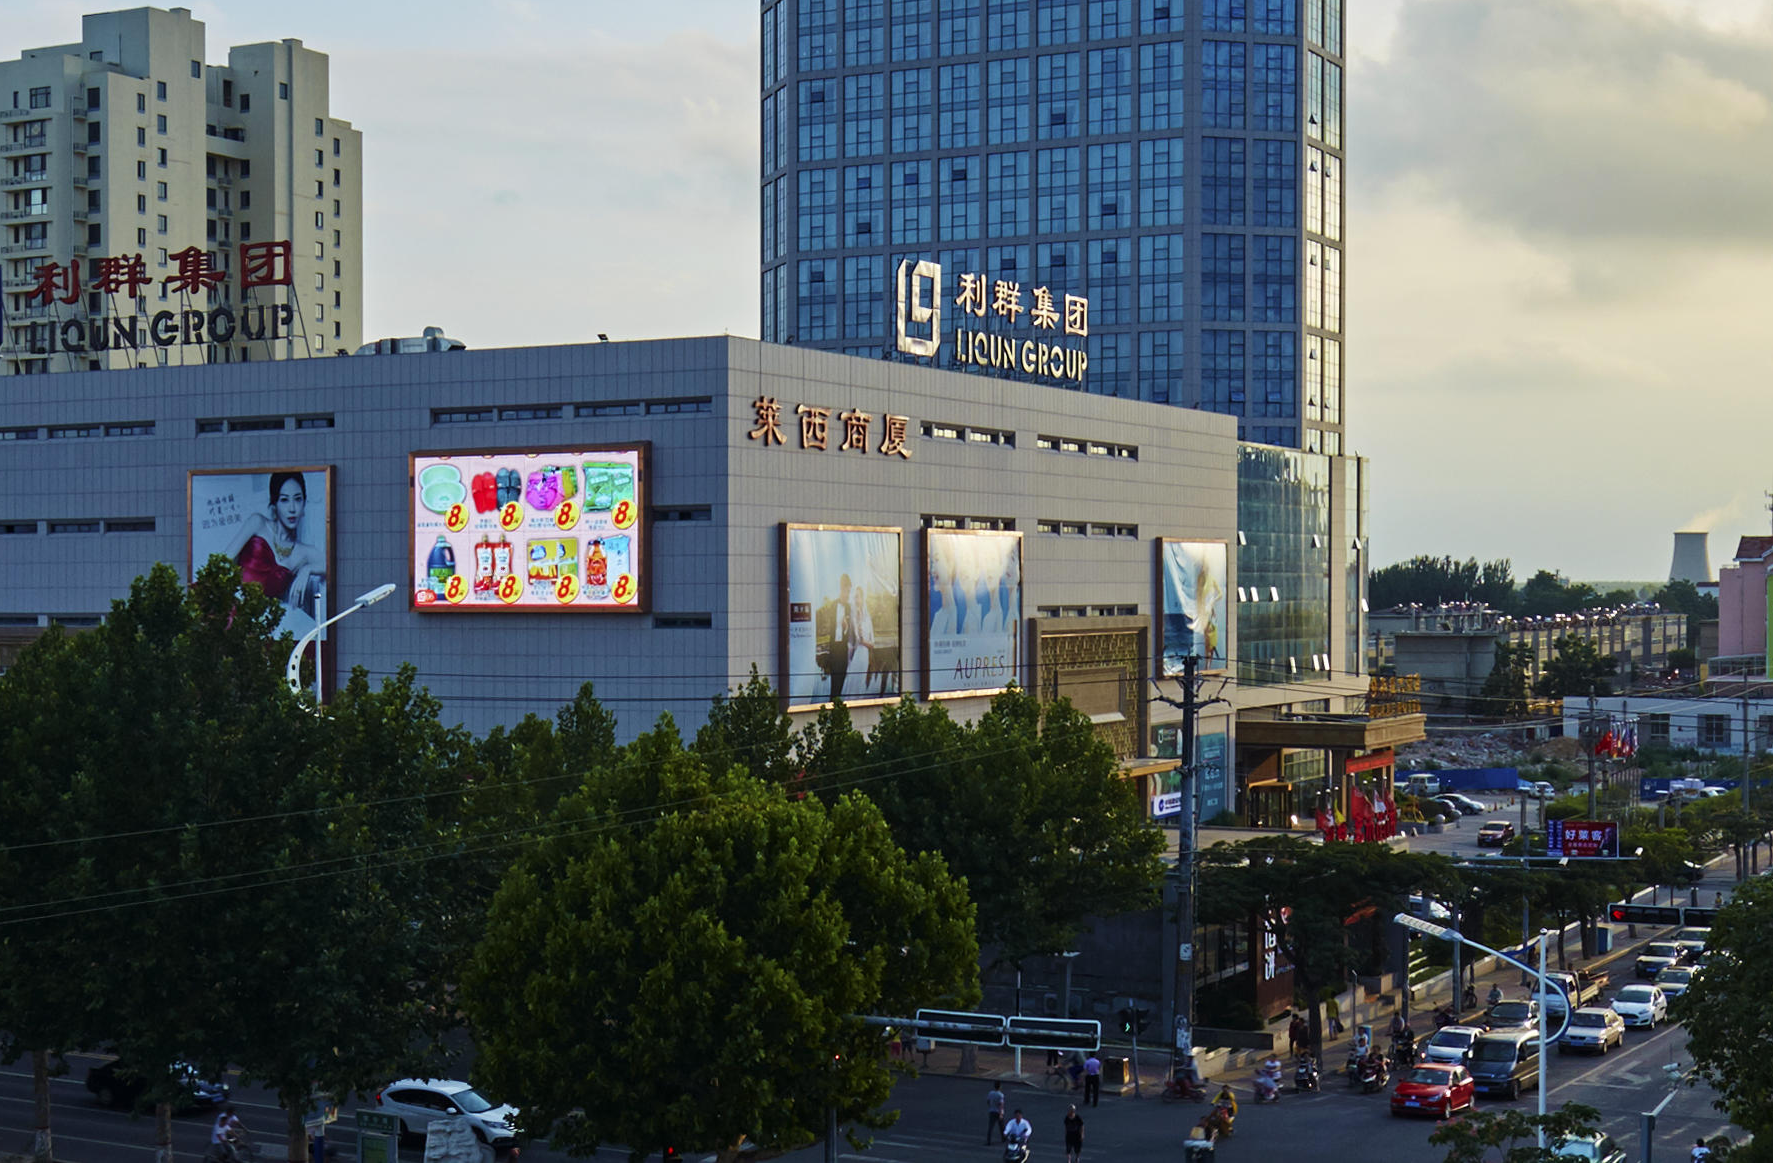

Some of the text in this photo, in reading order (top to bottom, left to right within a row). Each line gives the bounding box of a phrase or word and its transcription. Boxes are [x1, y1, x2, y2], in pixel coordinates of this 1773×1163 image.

[27, 240, 292, 305] 利群集团
[31, 304, 293, 354] LIQUN GROUP
[955, 272, 1089, 337] 利群集团
[956, 328, 1088, 382] LIQUN GROUP
[748, 396, 913, 459] 莱西商厦
[954, 655, 1005, 680] AUPRES
